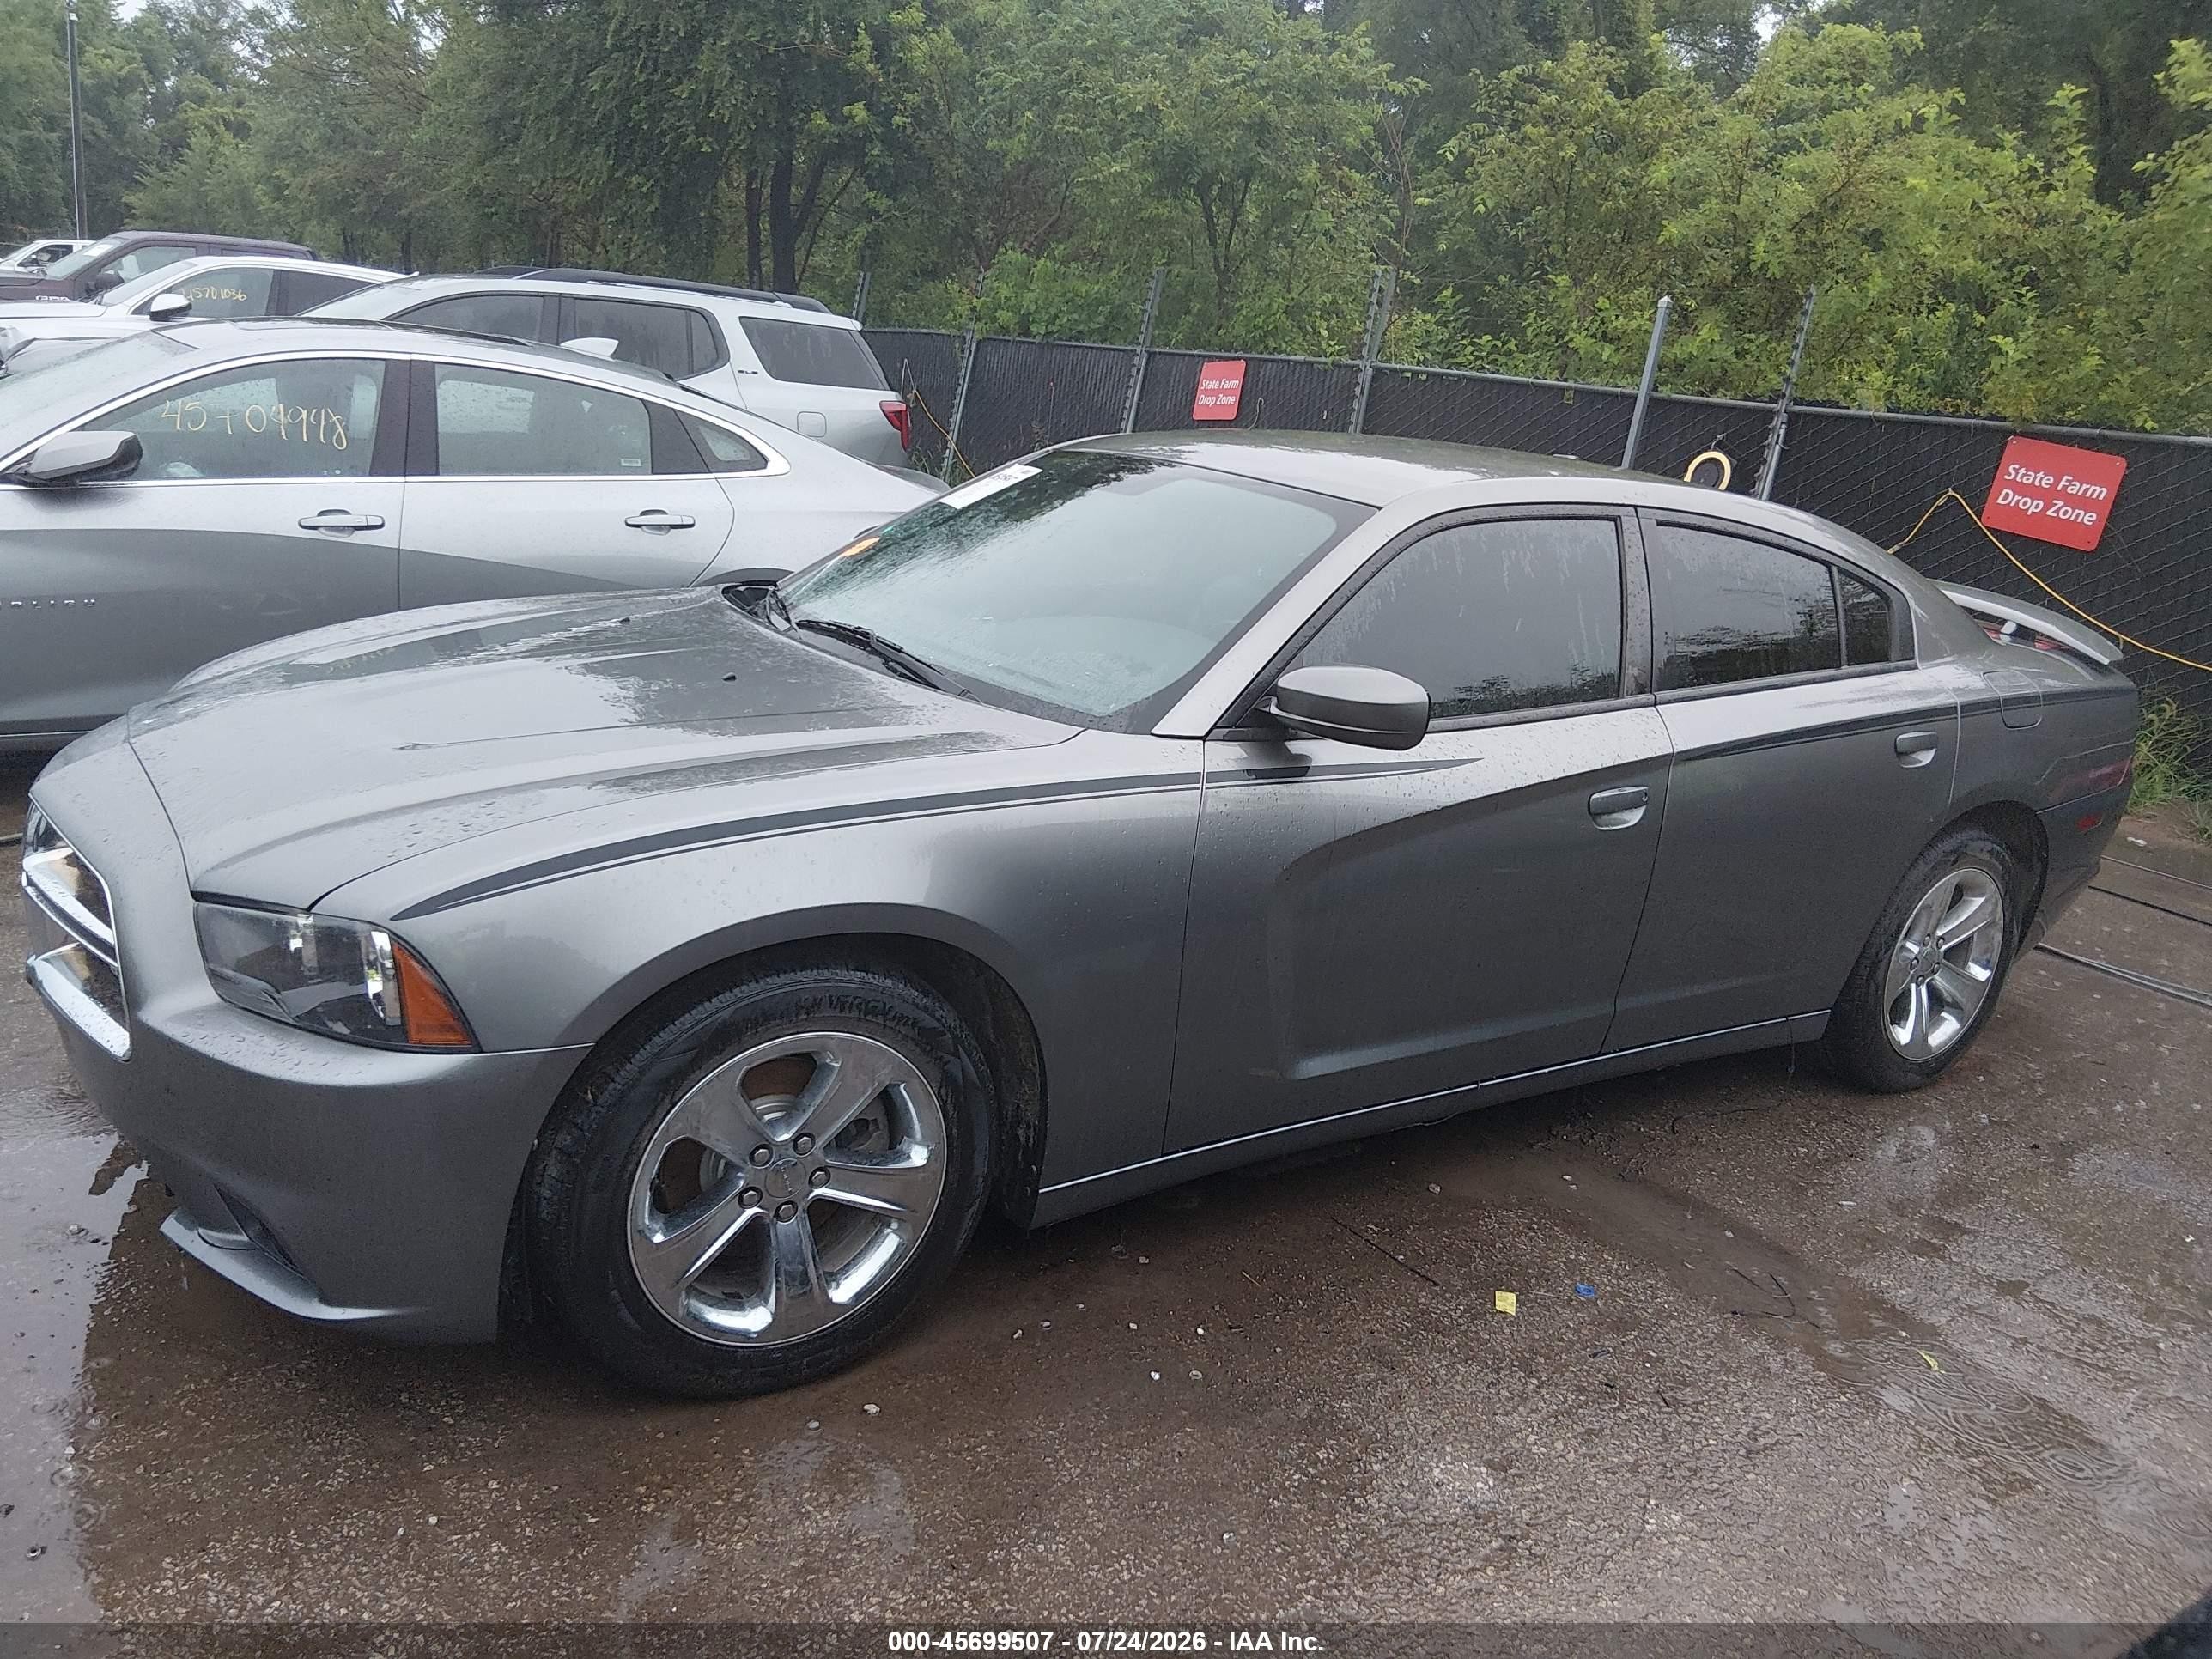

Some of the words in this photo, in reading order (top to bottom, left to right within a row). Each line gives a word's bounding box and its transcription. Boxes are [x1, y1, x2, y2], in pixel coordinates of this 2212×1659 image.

[1201, 380, 1220, 390] State
[1220, 378, 1240, 389] Farm
[1198, 395, 1216, 408] Drop
[1216, 393, 1236, 405] Zone
[2003, 464, 2055, 489] State
[2057, 475, 2108, 501] Farm
[1996, 489, 2045, 516] Drop
[2045, 500, 2098, 526] Zone
